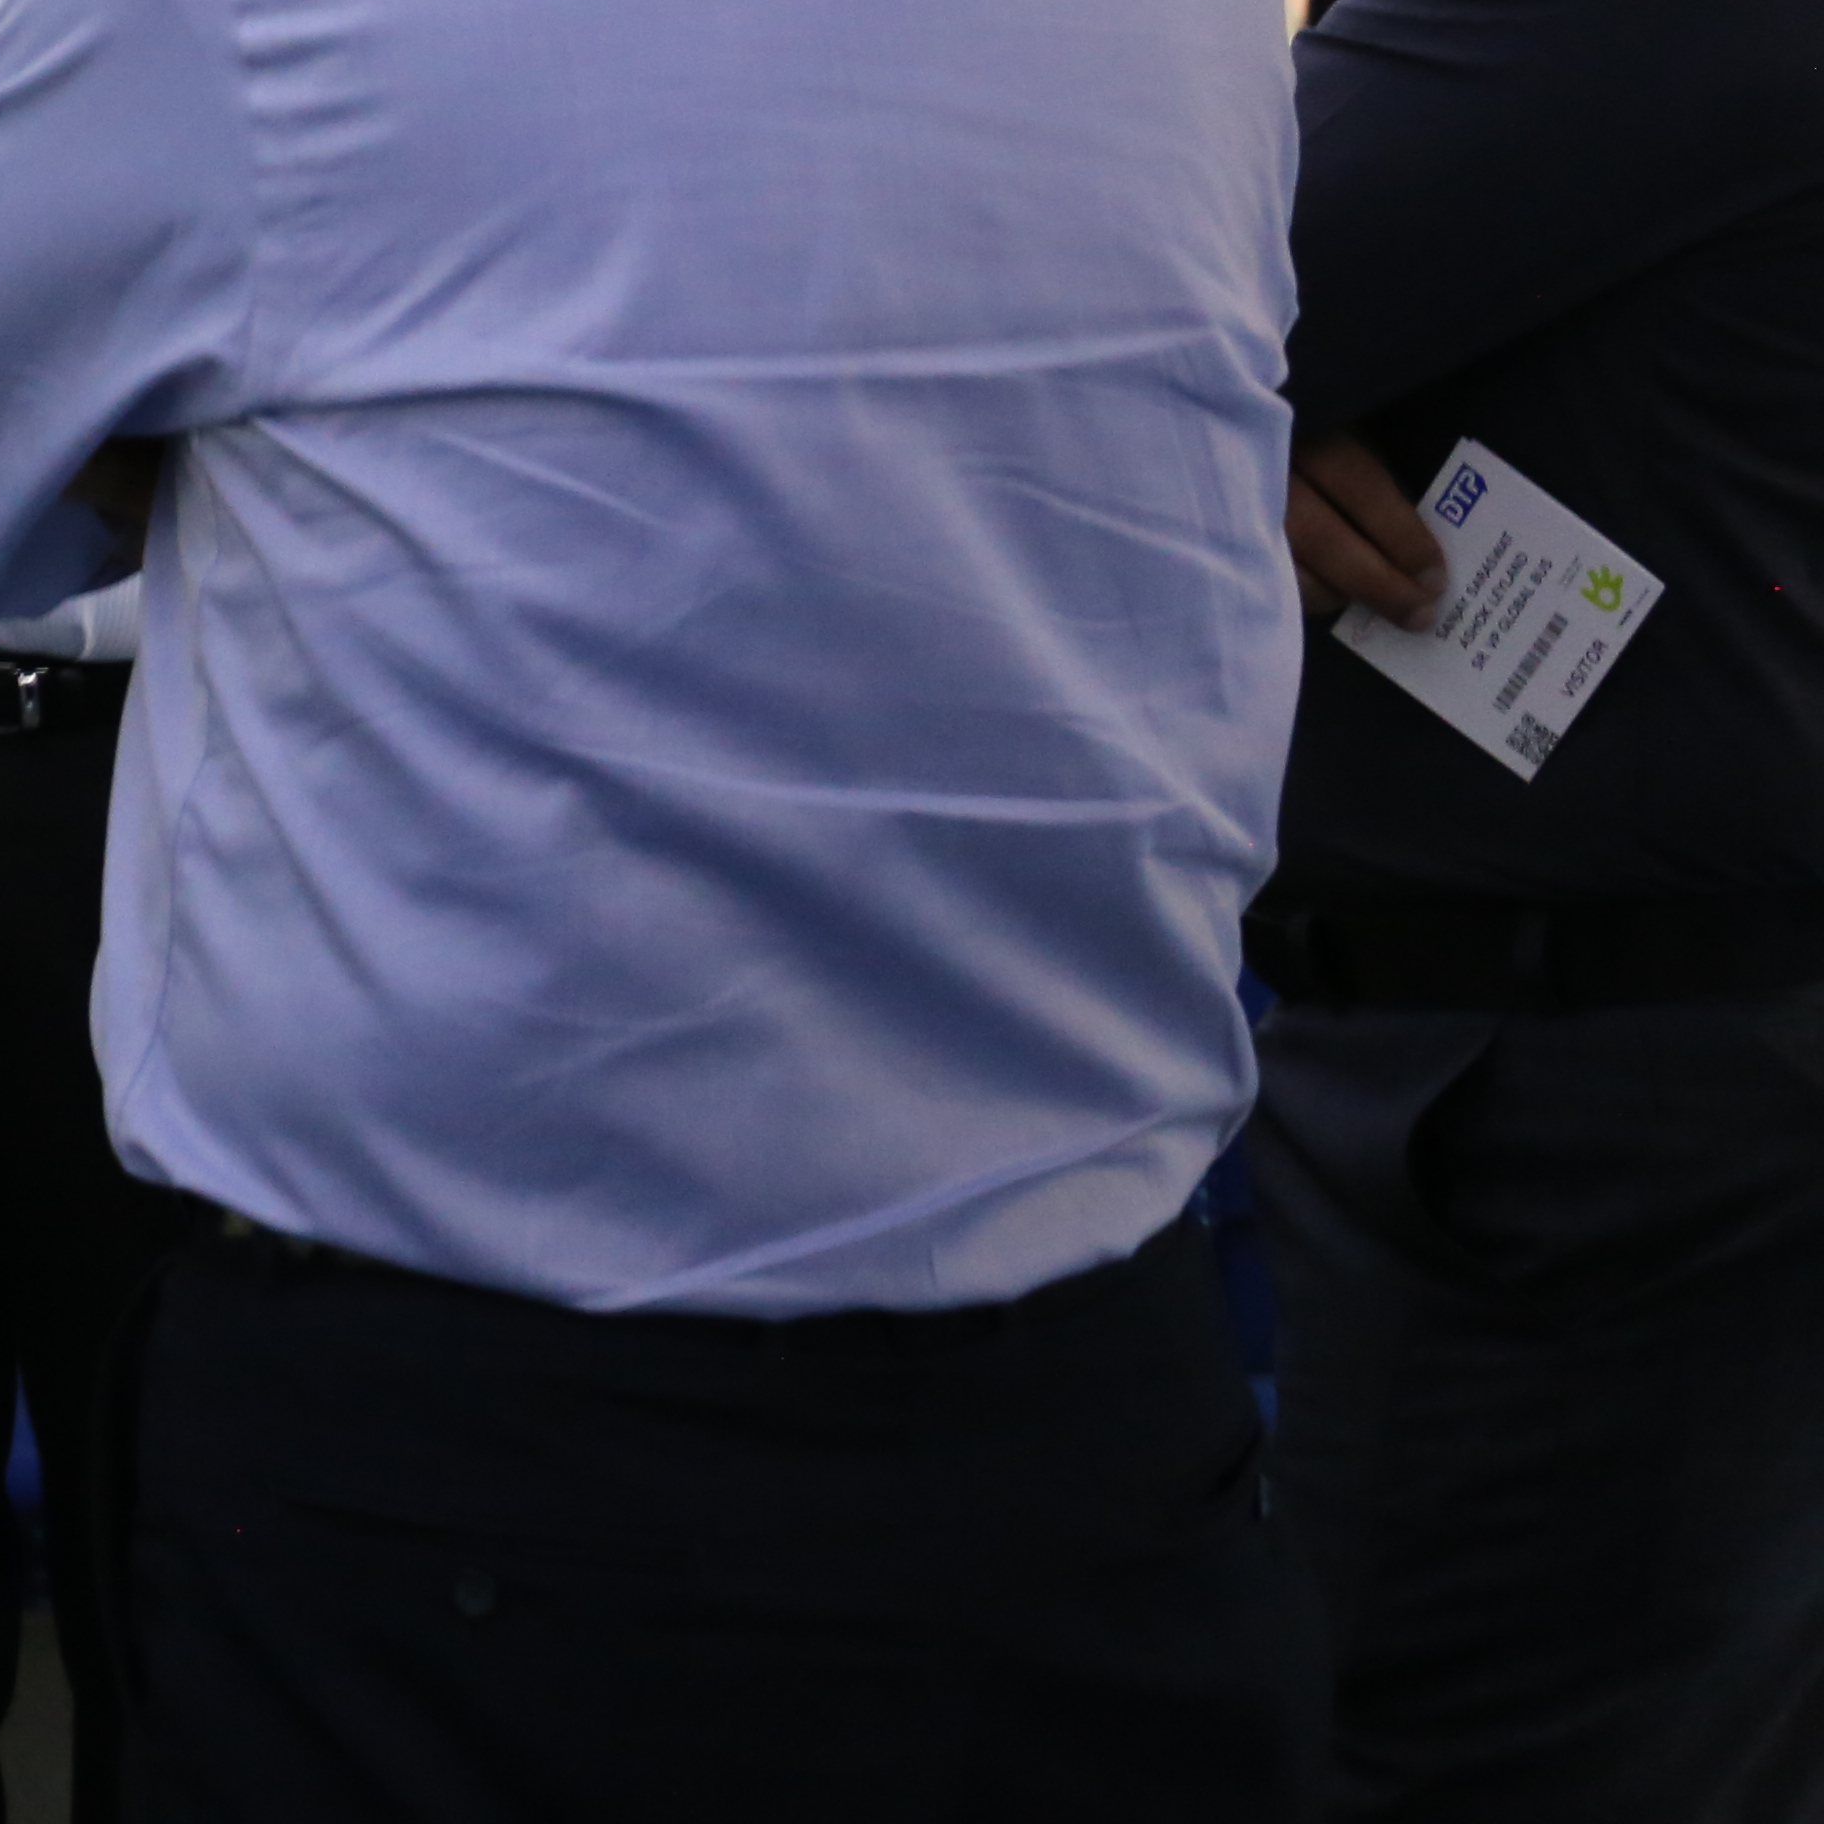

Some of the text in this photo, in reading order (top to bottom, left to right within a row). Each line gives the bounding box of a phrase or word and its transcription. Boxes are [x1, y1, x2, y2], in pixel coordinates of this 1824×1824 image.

[1458, 551, 1528, 651] ASHOK LEYLAND
[1498, 586, 1535, 633] GLOBAL
[1561, 639, 1608, 698] VISITOR
